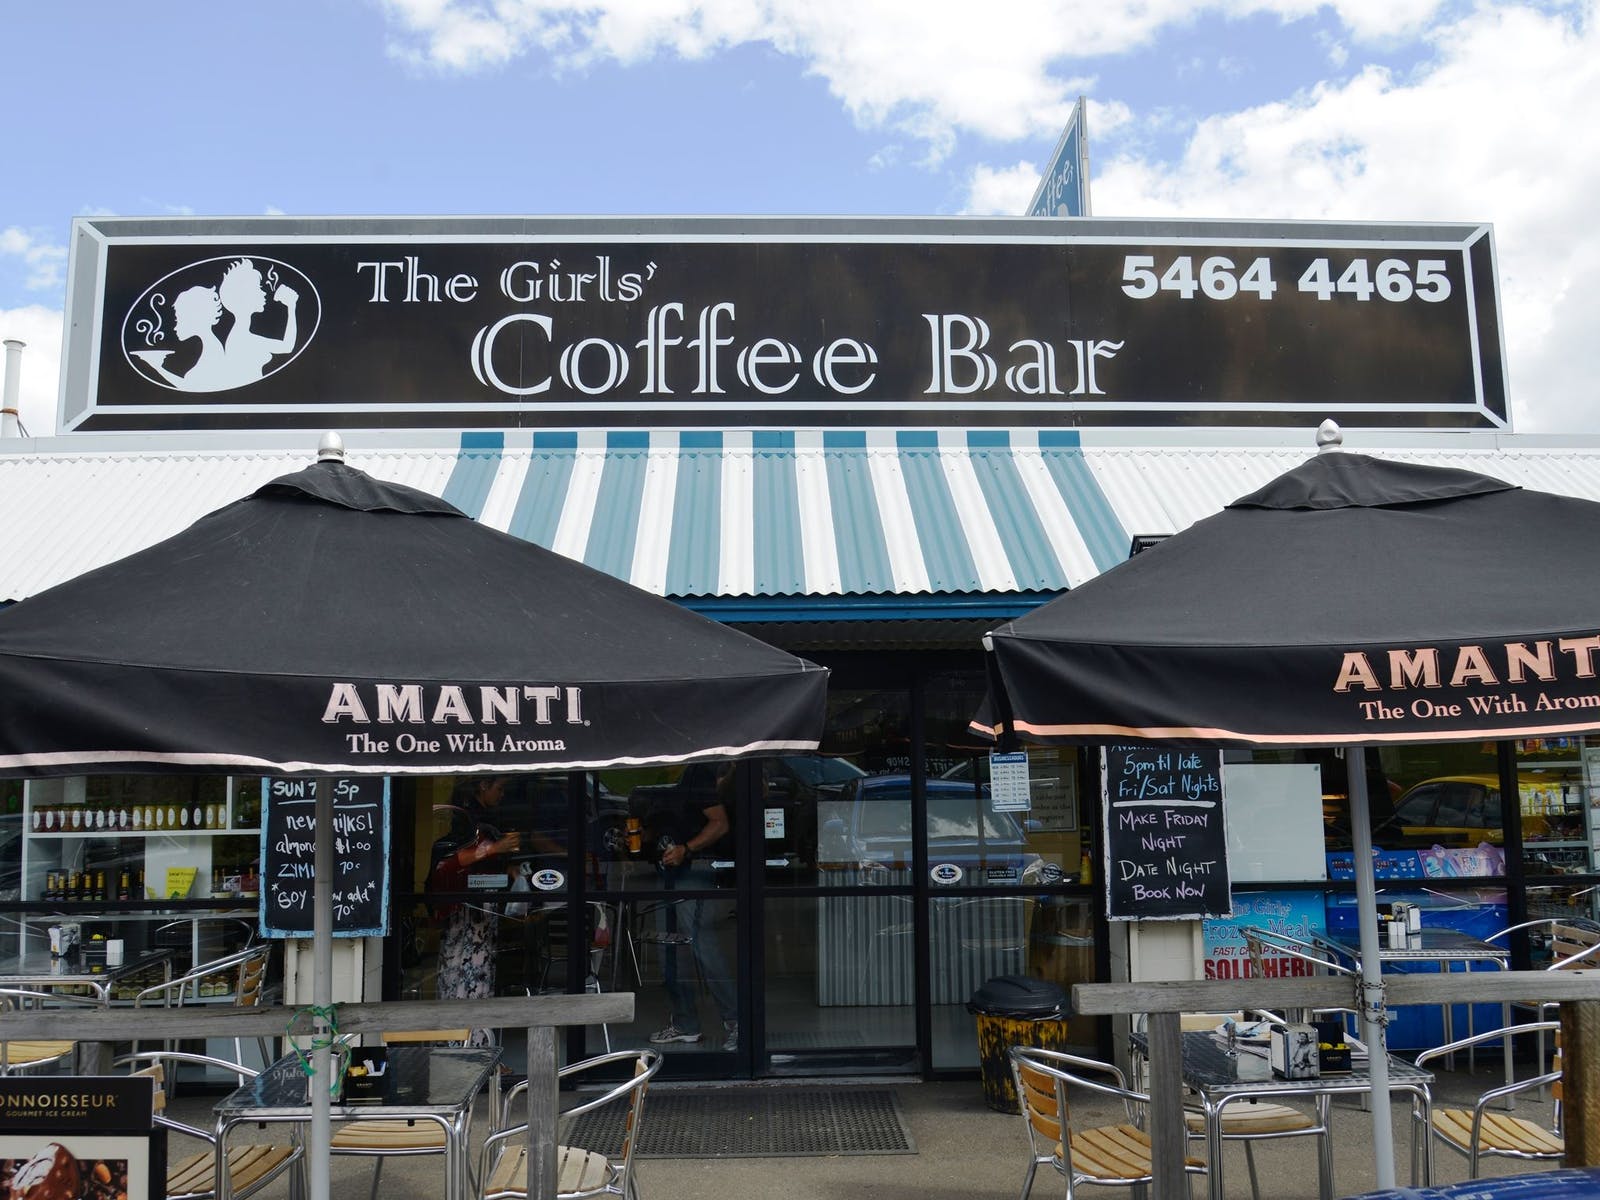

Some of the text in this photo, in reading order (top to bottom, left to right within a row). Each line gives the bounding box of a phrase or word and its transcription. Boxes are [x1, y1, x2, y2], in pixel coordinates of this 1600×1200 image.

[357, 256, 658, 303] The Girls'
[1121, 255, 1452, 303] 5464 4465
[470, 302, 1125, 395] Coffee Bar
[321, 682, 583, 725] AMANTI
[1359, 700, 1405, 720] The
[1411, 699, 1461, 718] One
[1467, 693, 1528, 715] With
[346, 733, 566, 753] The One With Aroma
[1123, 753, 1202, 779] 5pm til late
[272, 780, 304, 797] SUN
[1181, 773, 1219, 800] Nights
[1119, 809, 1208, 831] MAKE FRIDAY
[335, 837, 371, 854] $1.00
[1141, 832, 1187, 852] NIGHT
[1118, 856, 1217, 881] DATE NIGHT
[347, 885, 370, 904] add
[1132, 881, 1206, 900] BOOK NOW
[6, 1110, 87, 1118] GOURMET ICE CREAM
